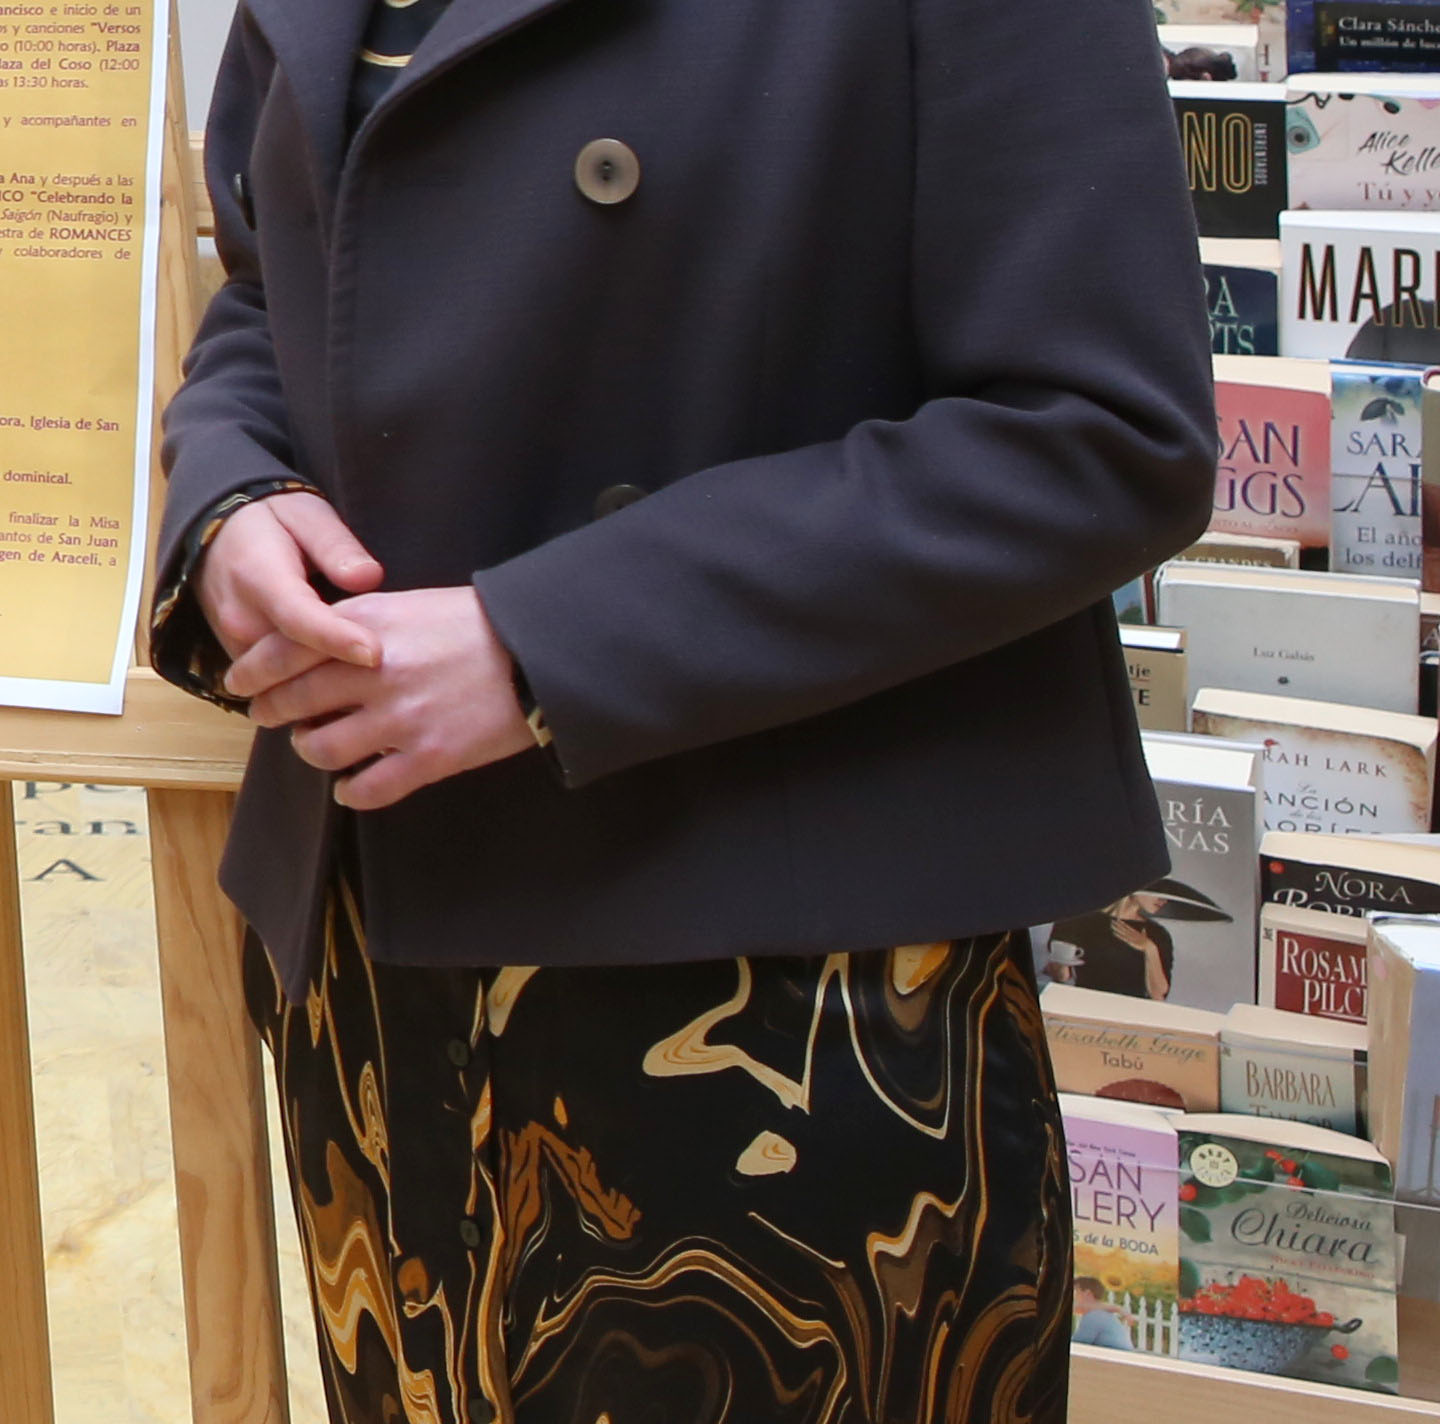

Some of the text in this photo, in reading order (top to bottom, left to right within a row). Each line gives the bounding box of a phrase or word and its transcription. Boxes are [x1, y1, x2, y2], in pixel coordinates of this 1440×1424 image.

[49, 6, 58, 15] e
[64, 4, 97, 16] inicio
[103, 4, 120, 16] de
[125, 6, 141, 16] un
[12, 24, 20, 36] y
[25, 23, 85, 34] canciones
[1338, 16, 1382, 31] Clara
[1339, 36, 1358, 47] Un
[1402, 38, 1415, 49] de
[1357, 130, 1410, 154] Alice
[1357, 181, 1393, 201] Tú
[1402, 188, 1416, 208] y
[1357, 527, 1377, 544] El
[1345, 548, 1375, 567] los
[1326, 757, 1387, 778] LARK
[1315, 871, 1414, 905] NORA
[1099, 1051, 1144, 1071] Tabú
[1246, 1059, 1337, 1109] BARBARA
[1286, 1201, 1372, 1231] Deliciosa
[1084, 1233, 1099, 1245] de
[1102, 1235, 1114, 1248] la
[1119, 1237, 1160, 1256] BODA
[1231, 1207, 1380, 1265] Chiara
